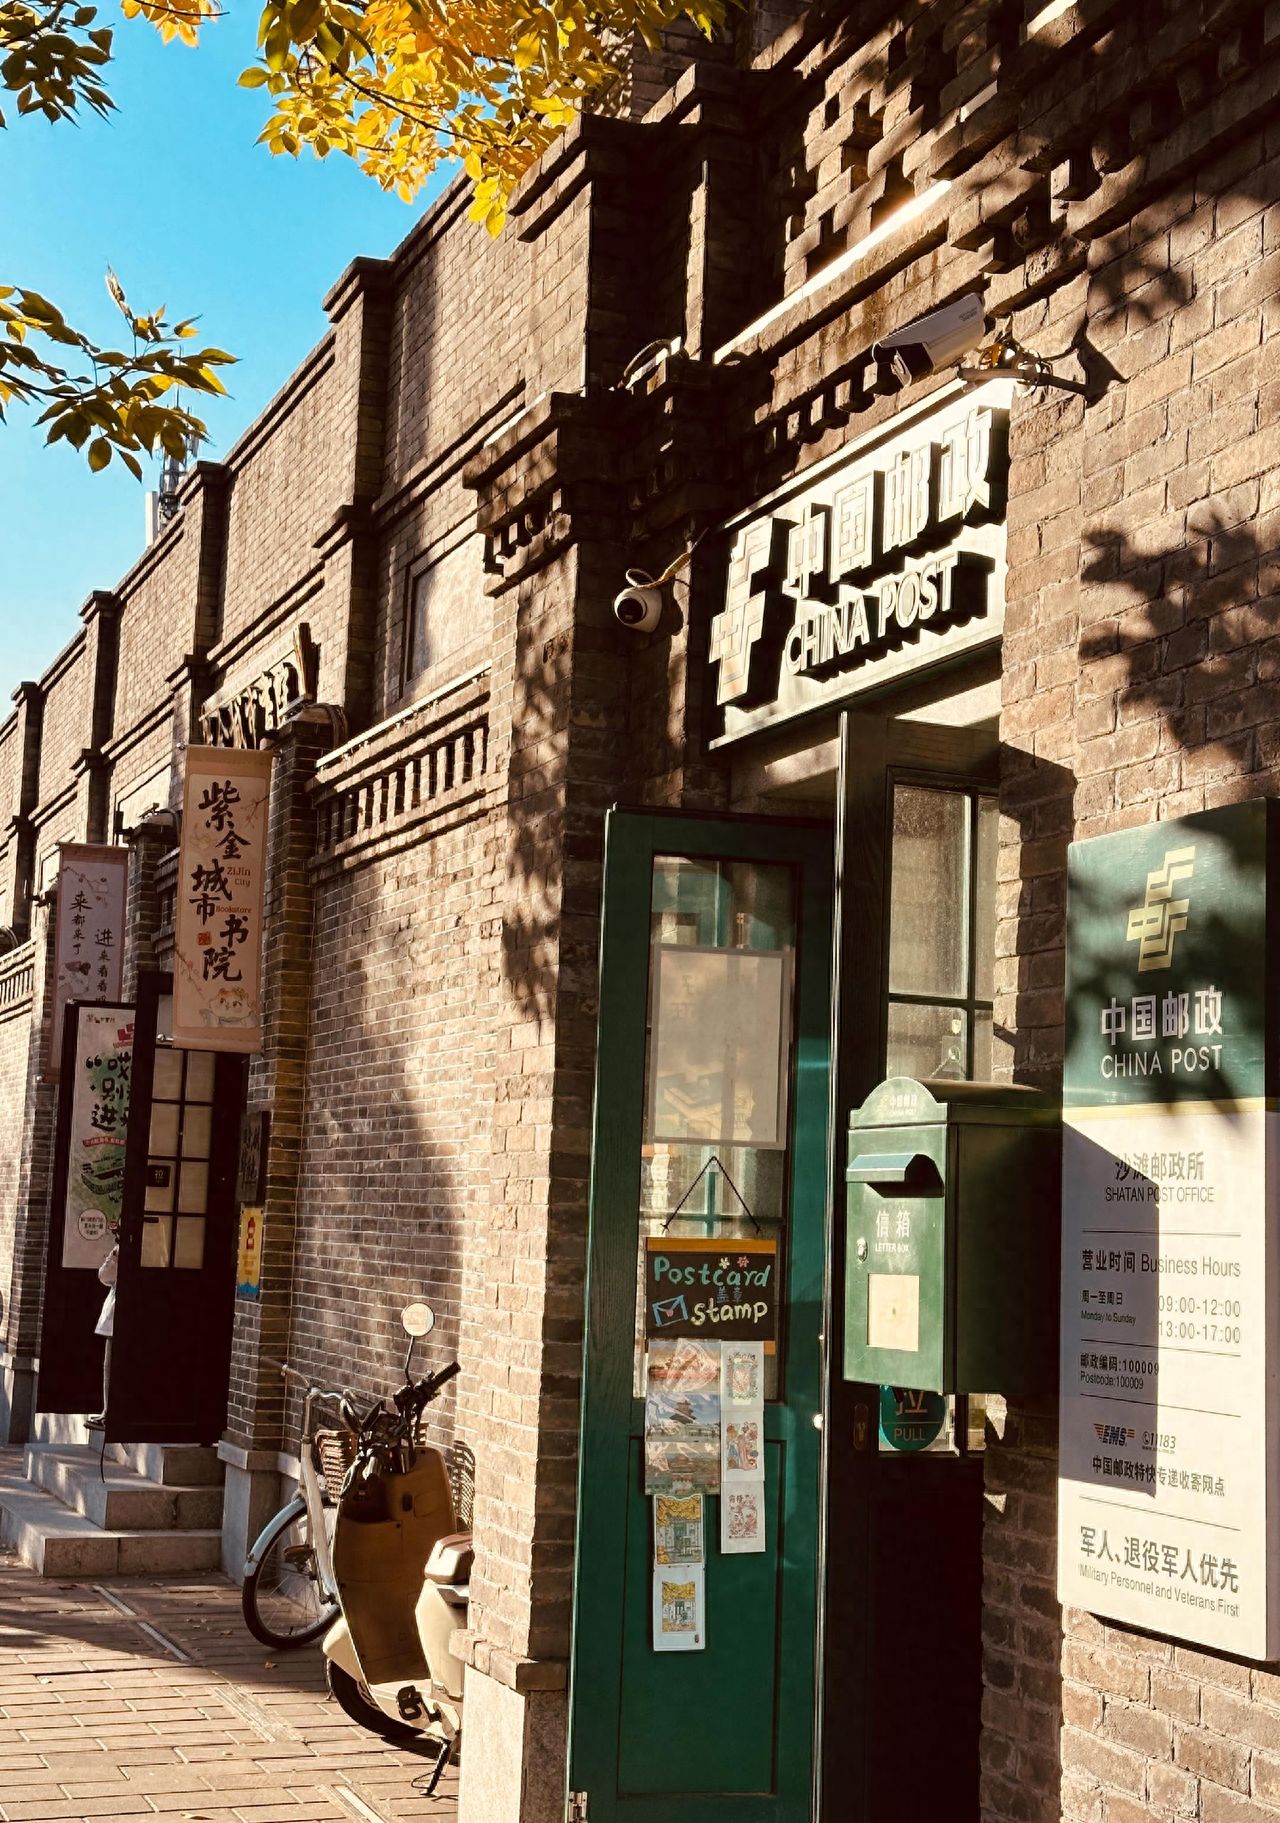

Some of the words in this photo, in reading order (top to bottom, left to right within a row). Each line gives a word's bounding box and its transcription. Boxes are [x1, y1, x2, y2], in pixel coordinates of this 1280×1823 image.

[786, 405, 993, 598] 中国邮政
[785, 594, 870, 676] CHINA
[877, 551, 961, 638] POST
[189, 780, 252, 982] 紫金城市书院
[1101, 984, 1224, 1045] 中国邮政
[1101, 1050, 1162, 1079] CHINA
[1171, 1044, 1224, 1074] POST
[1115, 1151, 1205, 1181] 沙滩邮政所
[1105, 1186, 1145, 1202] SHATAN
[1147, 1186, 1174, 1202] POST
[1176, 1186, 1215, 1202] OFFICE
[875, 1210, 911, 1238] 信箱
[653, 1255, 771, 1287] Postcard
[1082, 1249, 1136, 1273] 营业时间
[1141, 1253, 1198, 1275] Business
[1202, 1255, 1241, 1278] Hours
[690, 1297, 769, 1326] stamp
[1081, 1310, 1105, 1323] Monday
[1113, 1313, 1137, 1326] Sunday
[1082, 1290, 1123, 1305] 周一至周日
[1158, 1295, 1241, 1318] 09:00-12:00
[1158, 1320, 1241, 1343] 13:00-17:00
[894, 1427, 926, 1441] PULL
[1150, 1433, 1177, 1449] 11183
[1092, 1455, 1225, 1497] 中国邮政特快专递收寄网点
[1080, 1525, 1239, 1594] 军人、退役军人优先
[1079, 1563, 1109, 1586] Military
[1110, 1571, 1154, 1596] Personnel
[1155, 1585, 1172, 1600] and
[1174, 1587, 1216, 1612] Veterans
[1217, 1598, 1240, 1619] First
